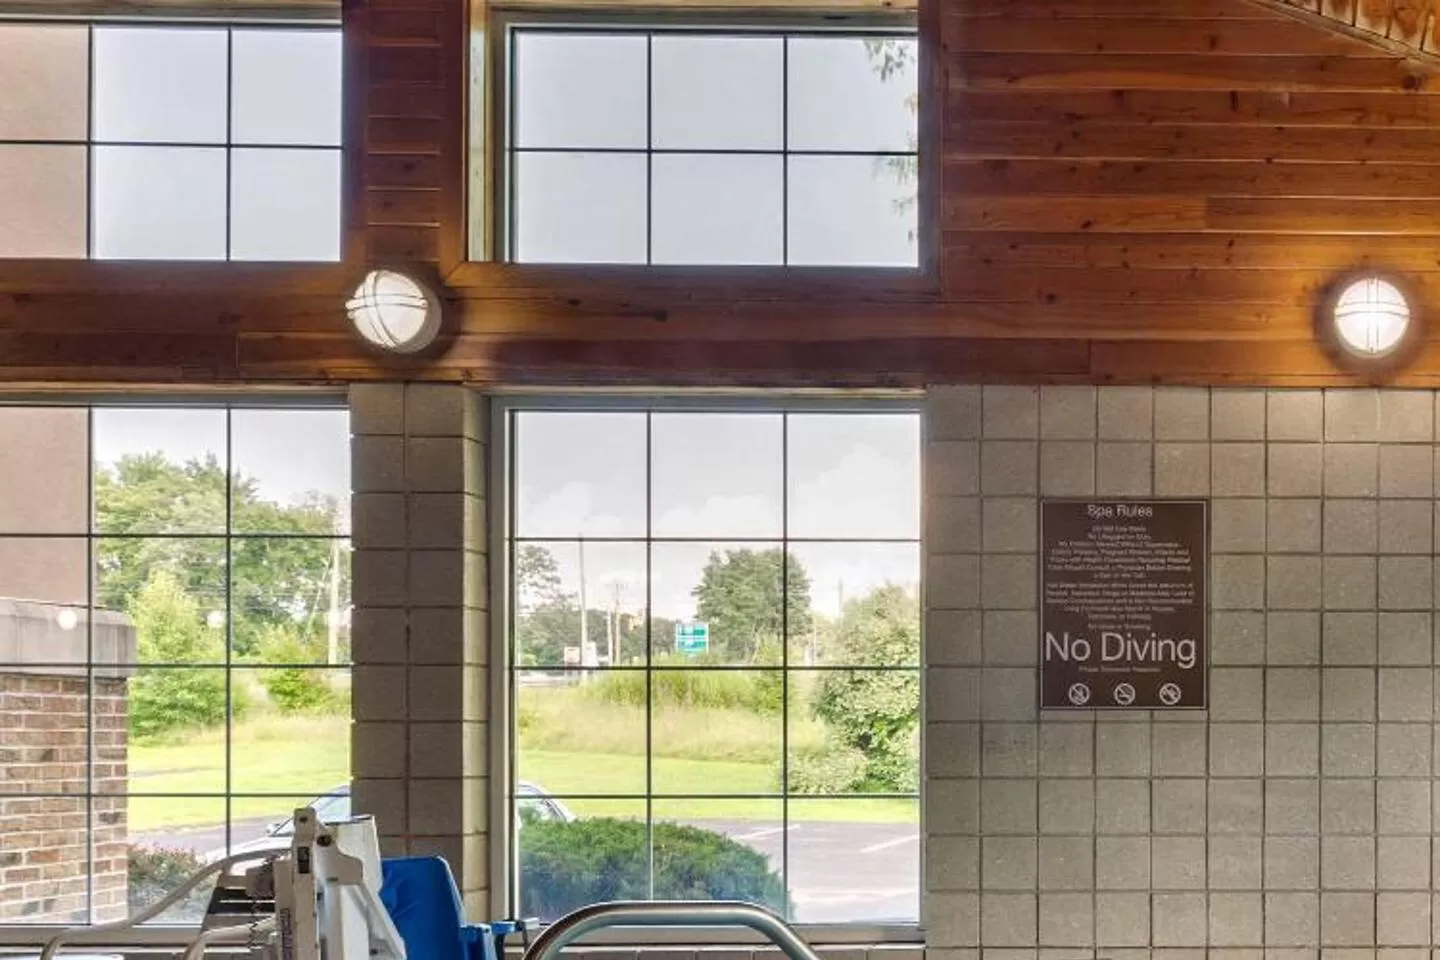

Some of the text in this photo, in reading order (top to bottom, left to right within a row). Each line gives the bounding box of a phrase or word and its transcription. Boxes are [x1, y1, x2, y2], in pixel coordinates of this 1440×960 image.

[1087, 504, 1153, 519] Spa Rules
[1045, 631, 1196, 669] No Diving
